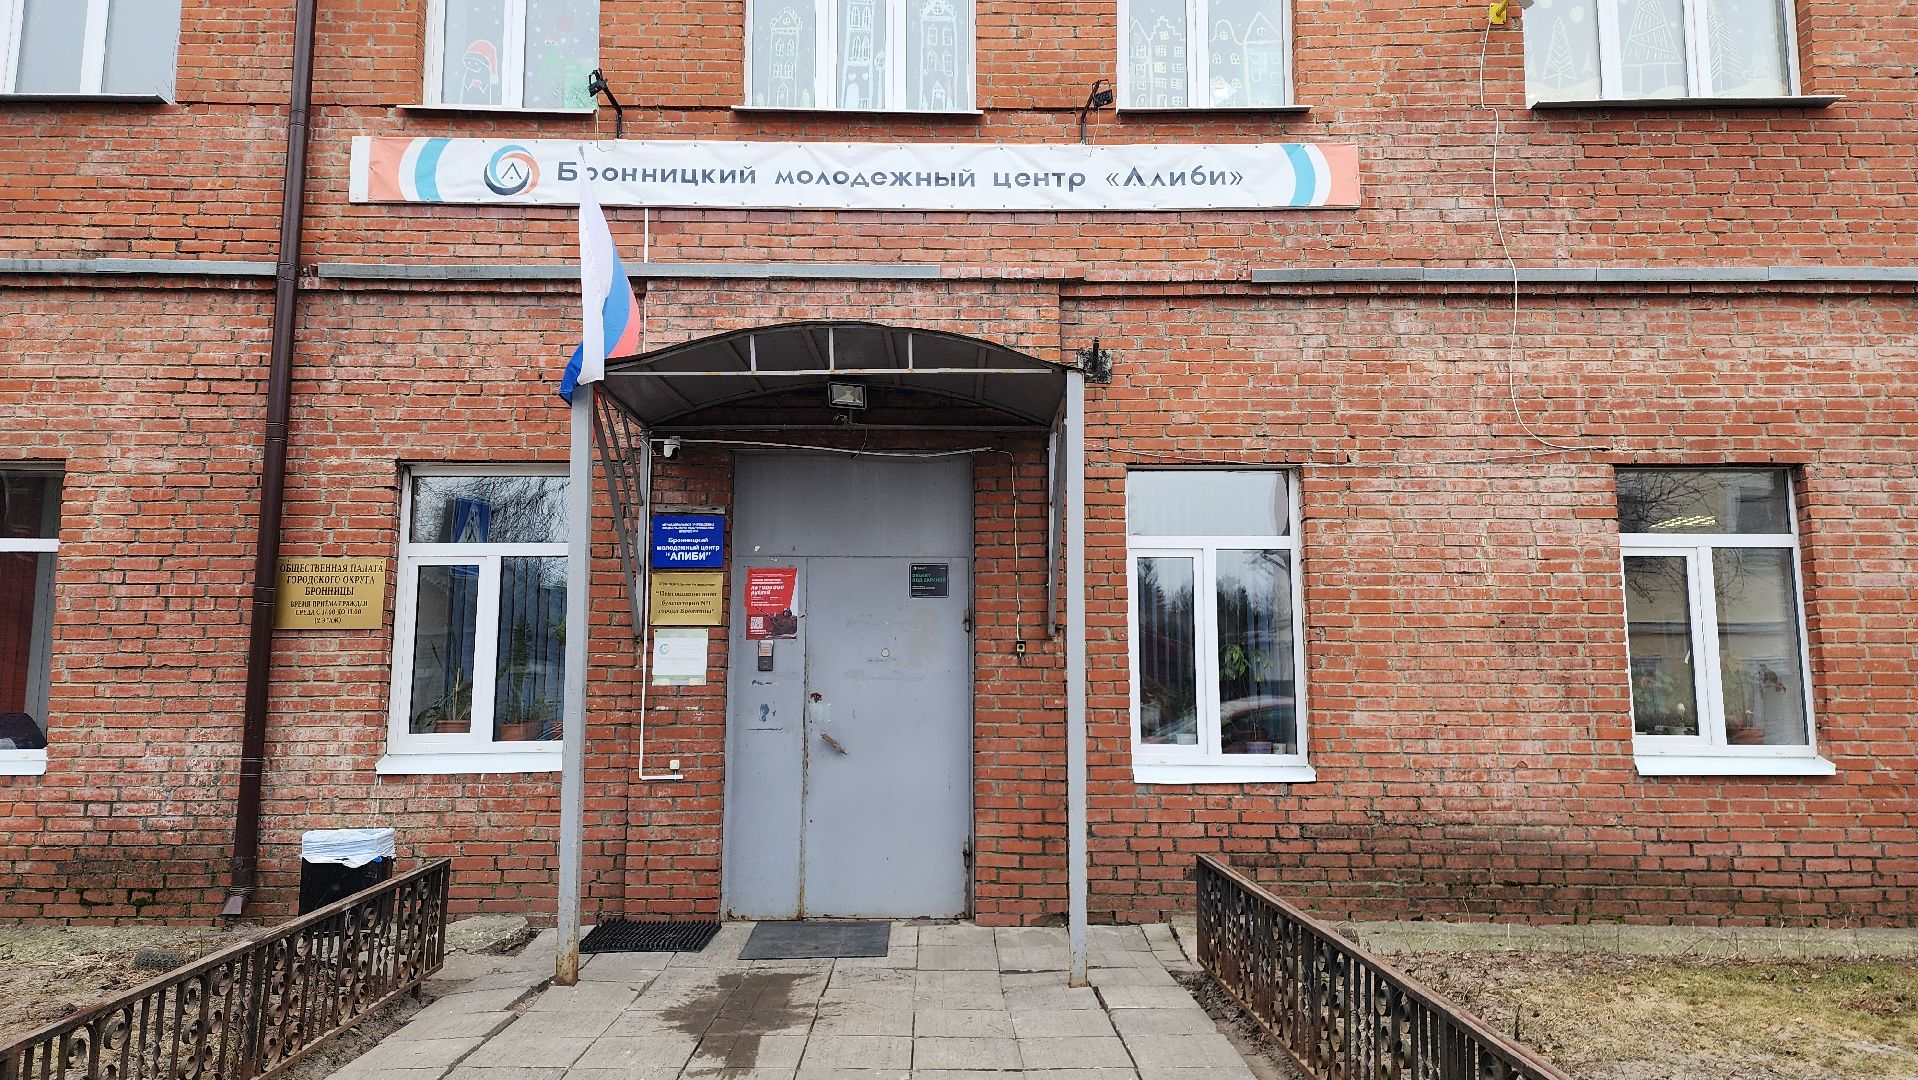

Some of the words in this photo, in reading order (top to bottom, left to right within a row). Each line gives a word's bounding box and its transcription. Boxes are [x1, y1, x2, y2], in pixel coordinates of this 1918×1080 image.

[774, 168, 976, 188] молодежный
[993, 171, 1086, 192] центр
[1105, 164, 1244, 186] «Алиби»
[280, 563, 348, 573] ОБЩЕСТВЕННАЯ
[350, 564, 384, 573] ПАЛАТА
[287, 575, 340, 585] ГОРОДСКОГО
[342, 575, 375, 584] ОКРУГА
[305, 586, 354, 596] БРОННИЦЫ
[338, 600, 368, 608] ГРАЖДАН
